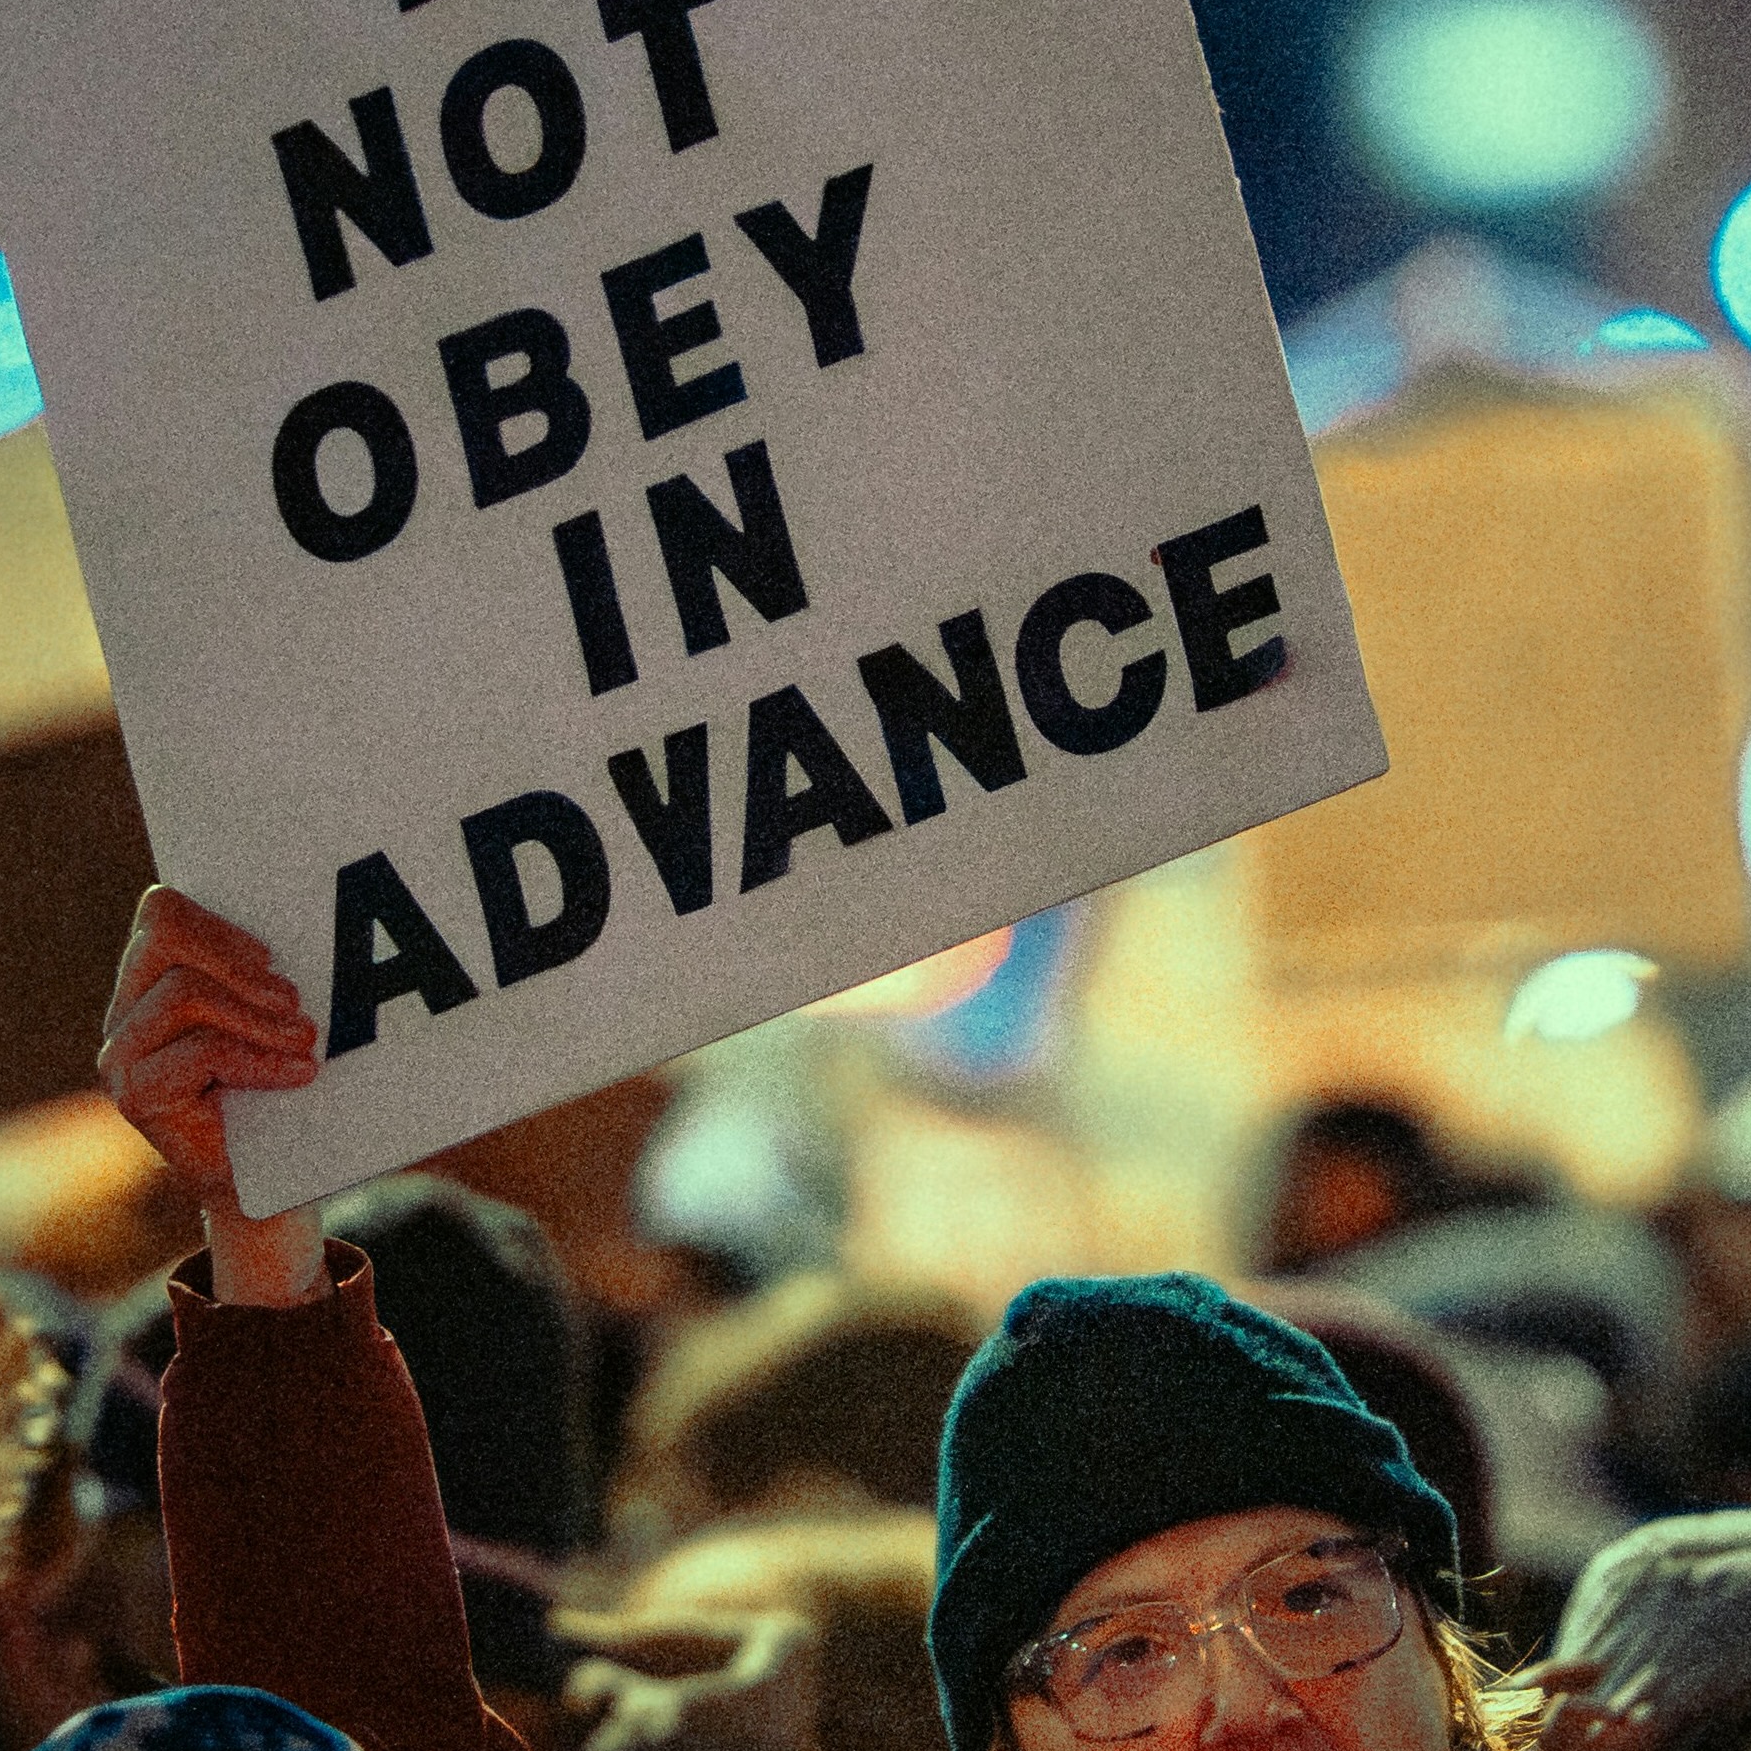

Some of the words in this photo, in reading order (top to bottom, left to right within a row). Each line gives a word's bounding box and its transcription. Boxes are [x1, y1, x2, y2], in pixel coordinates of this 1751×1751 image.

[270, 162, 874, 564] OBEY
[551, 438, 810, 697] IN
[323, 504, 1293, 1063] ADVANCE
